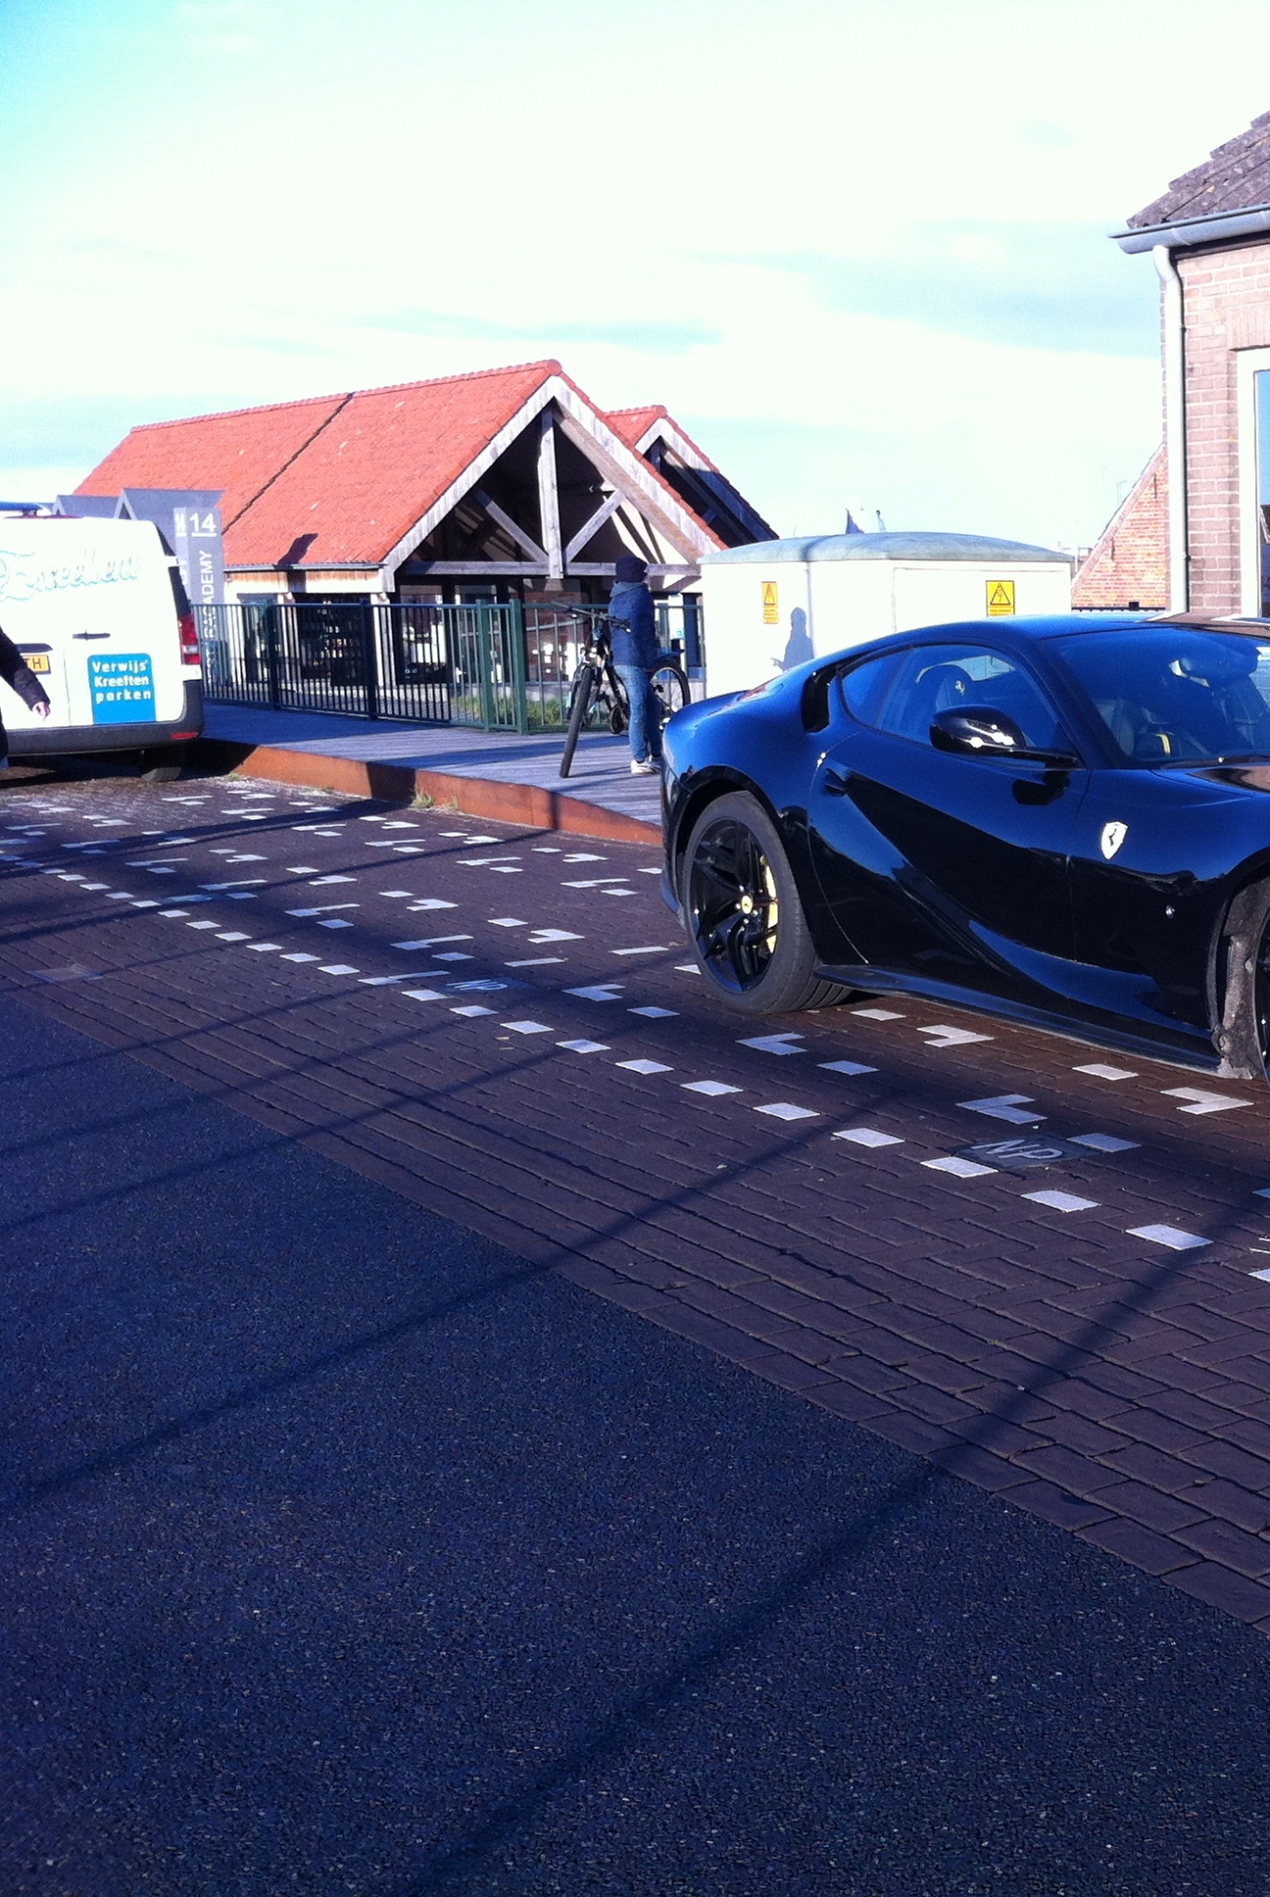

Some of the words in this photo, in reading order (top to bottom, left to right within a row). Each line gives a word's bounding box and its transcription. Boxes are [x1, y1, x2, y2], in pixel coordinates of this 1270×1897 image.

[190, 513, 217, 533] 14
[96, 689, 151, 704] parken
[971, 1139, 1063, 1159] NP
